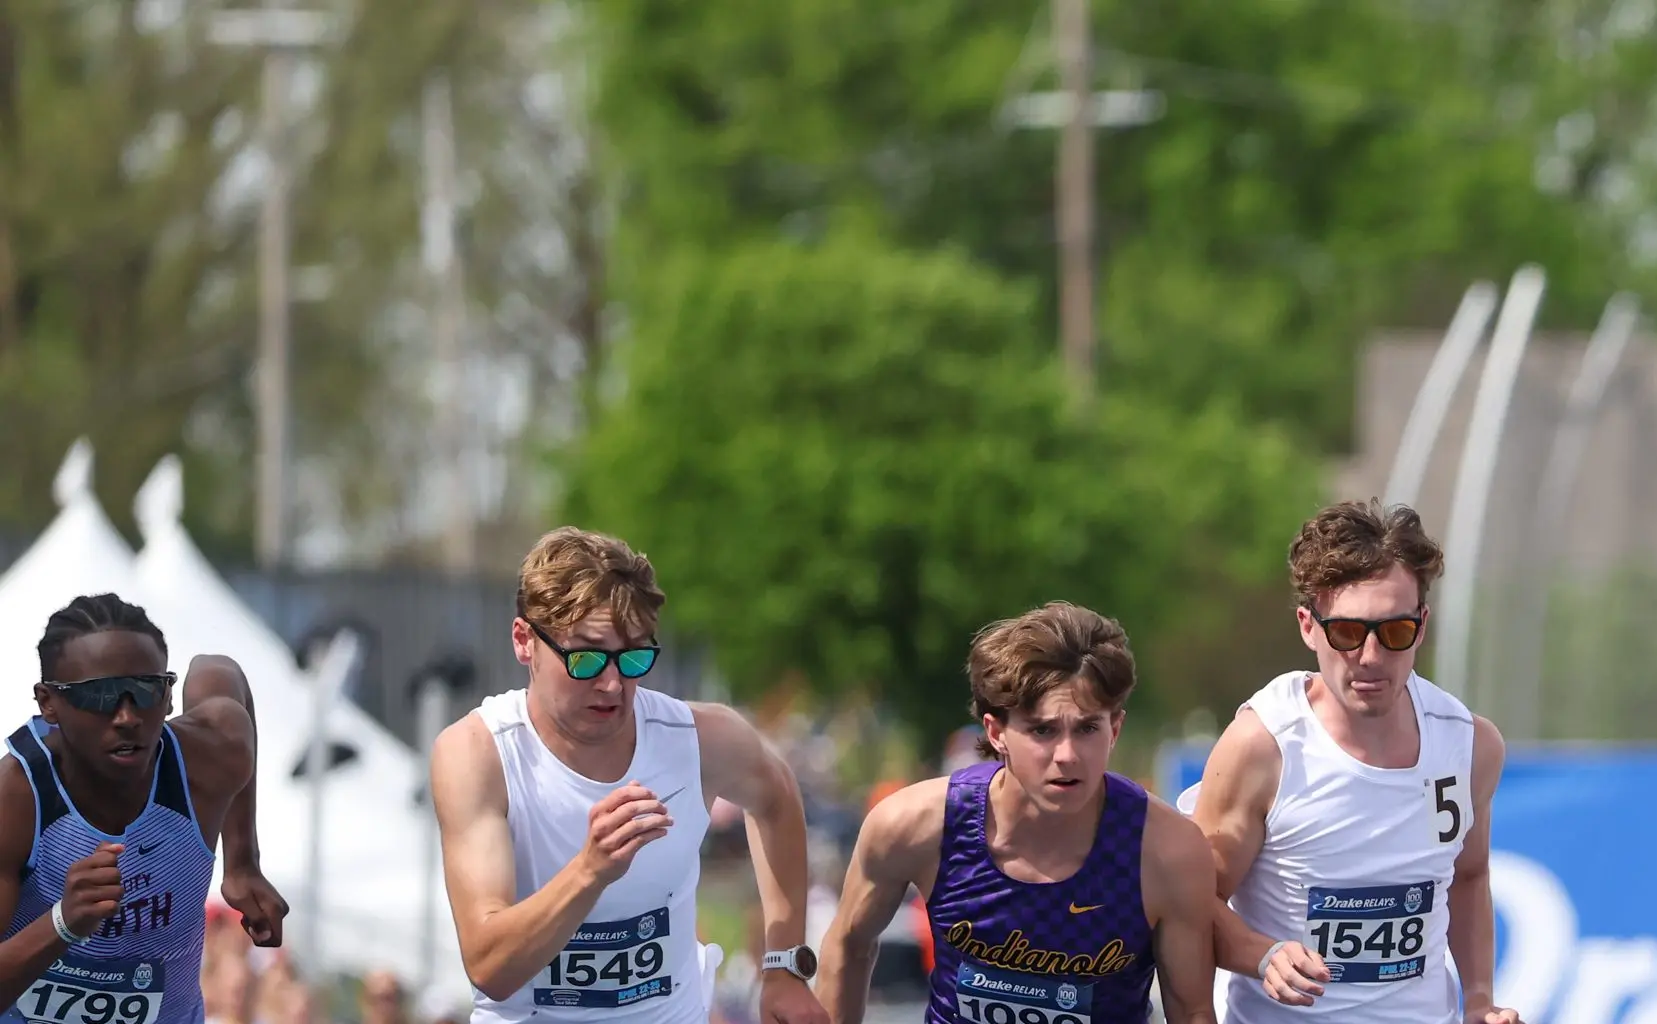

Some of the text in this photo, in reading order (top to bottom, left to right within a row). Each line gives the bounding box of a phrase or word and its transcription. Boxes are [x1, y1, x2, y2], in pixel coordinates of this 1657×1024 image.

[1434, 775, 1462, 843] 5
[1323, 895, 1396, 909] Drake RELAYS
[594, 930, 628, 941] RELAYS
[944, 919, 1137, 977] Indianola
[1310, 917, 1424, 960] 1548
[49, 958, 126, 982] Drake RELAYS
[547, 941, 664, 987] 1549
[971, 973, 1047, 999] Drake RELAYS
[1059, 989, 1076, 1001] 100
